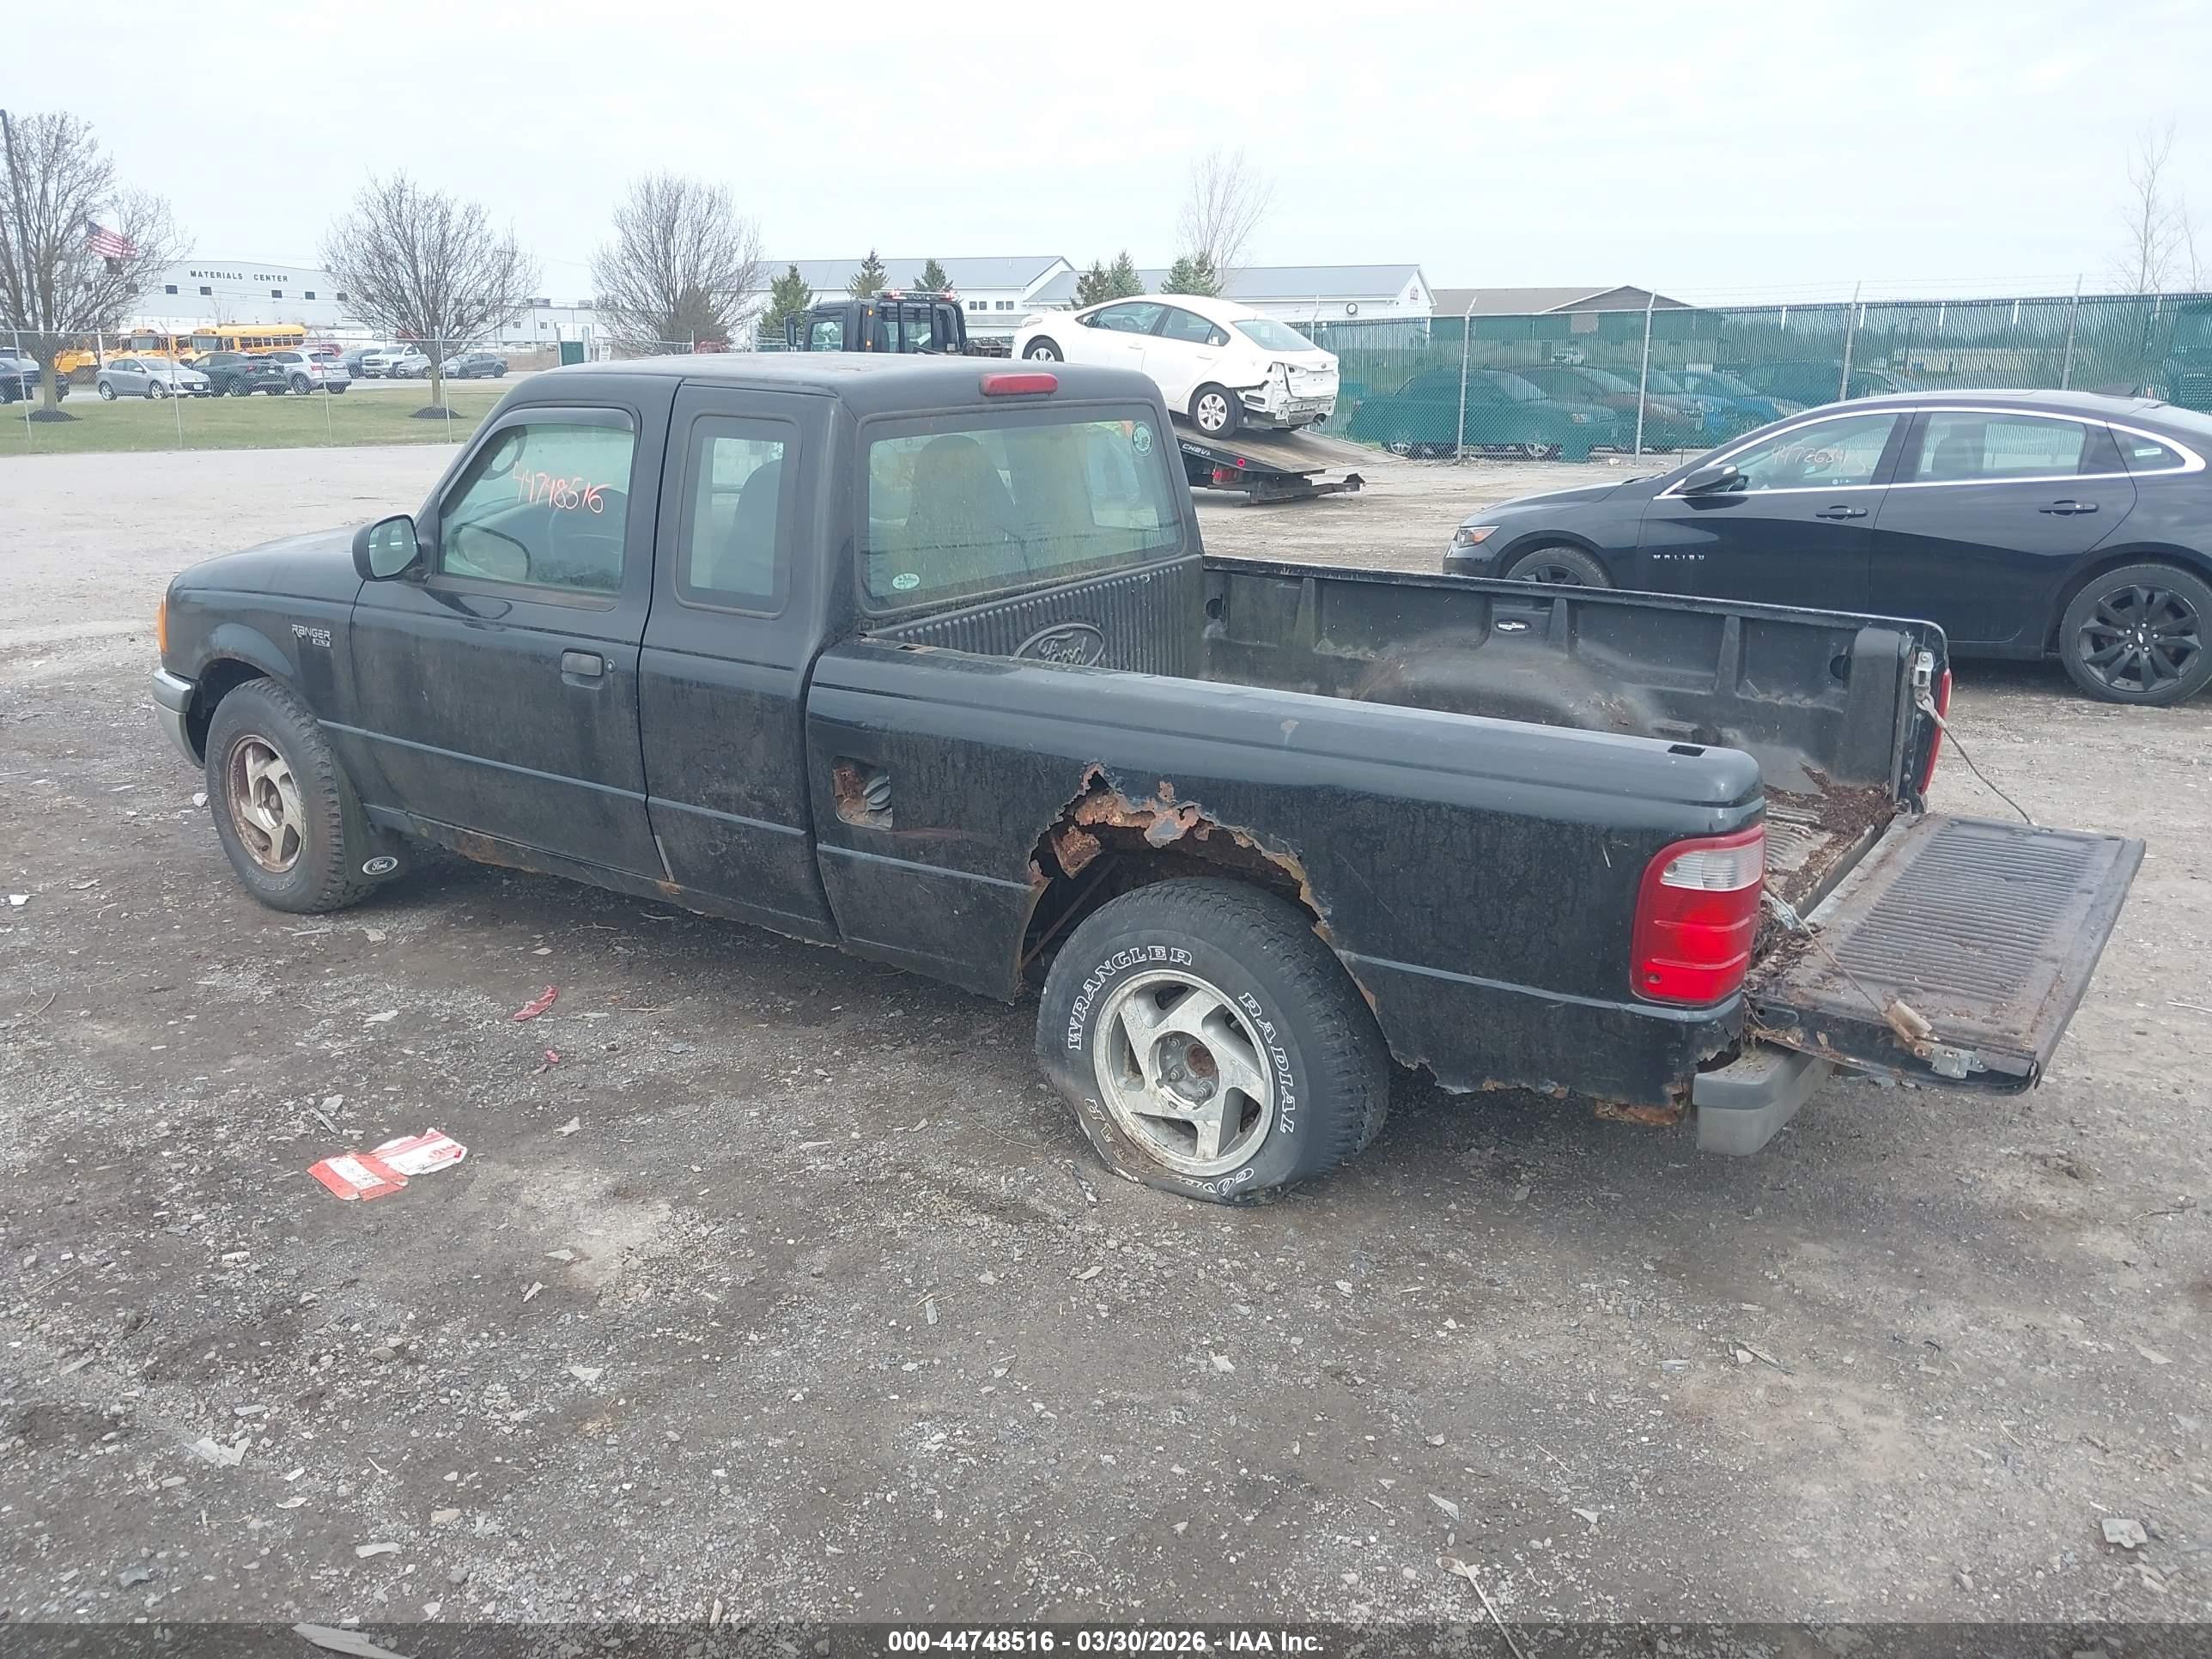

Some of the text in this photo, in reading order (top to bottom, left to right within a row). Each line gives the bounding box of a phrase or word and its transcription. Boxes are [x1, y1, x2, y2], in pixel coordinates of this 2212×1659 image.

[190, 270, 289, 283] MATERIALS CENTER
[513, 461, 612, 514] 44748516
[291, 624, 330, 640] RANGER
[1037, 631, 1087, 664] Ford
[1067, 945, 1193, 1051] WRANGLER
[1238, 992, 1297, 1134] RADIAL
